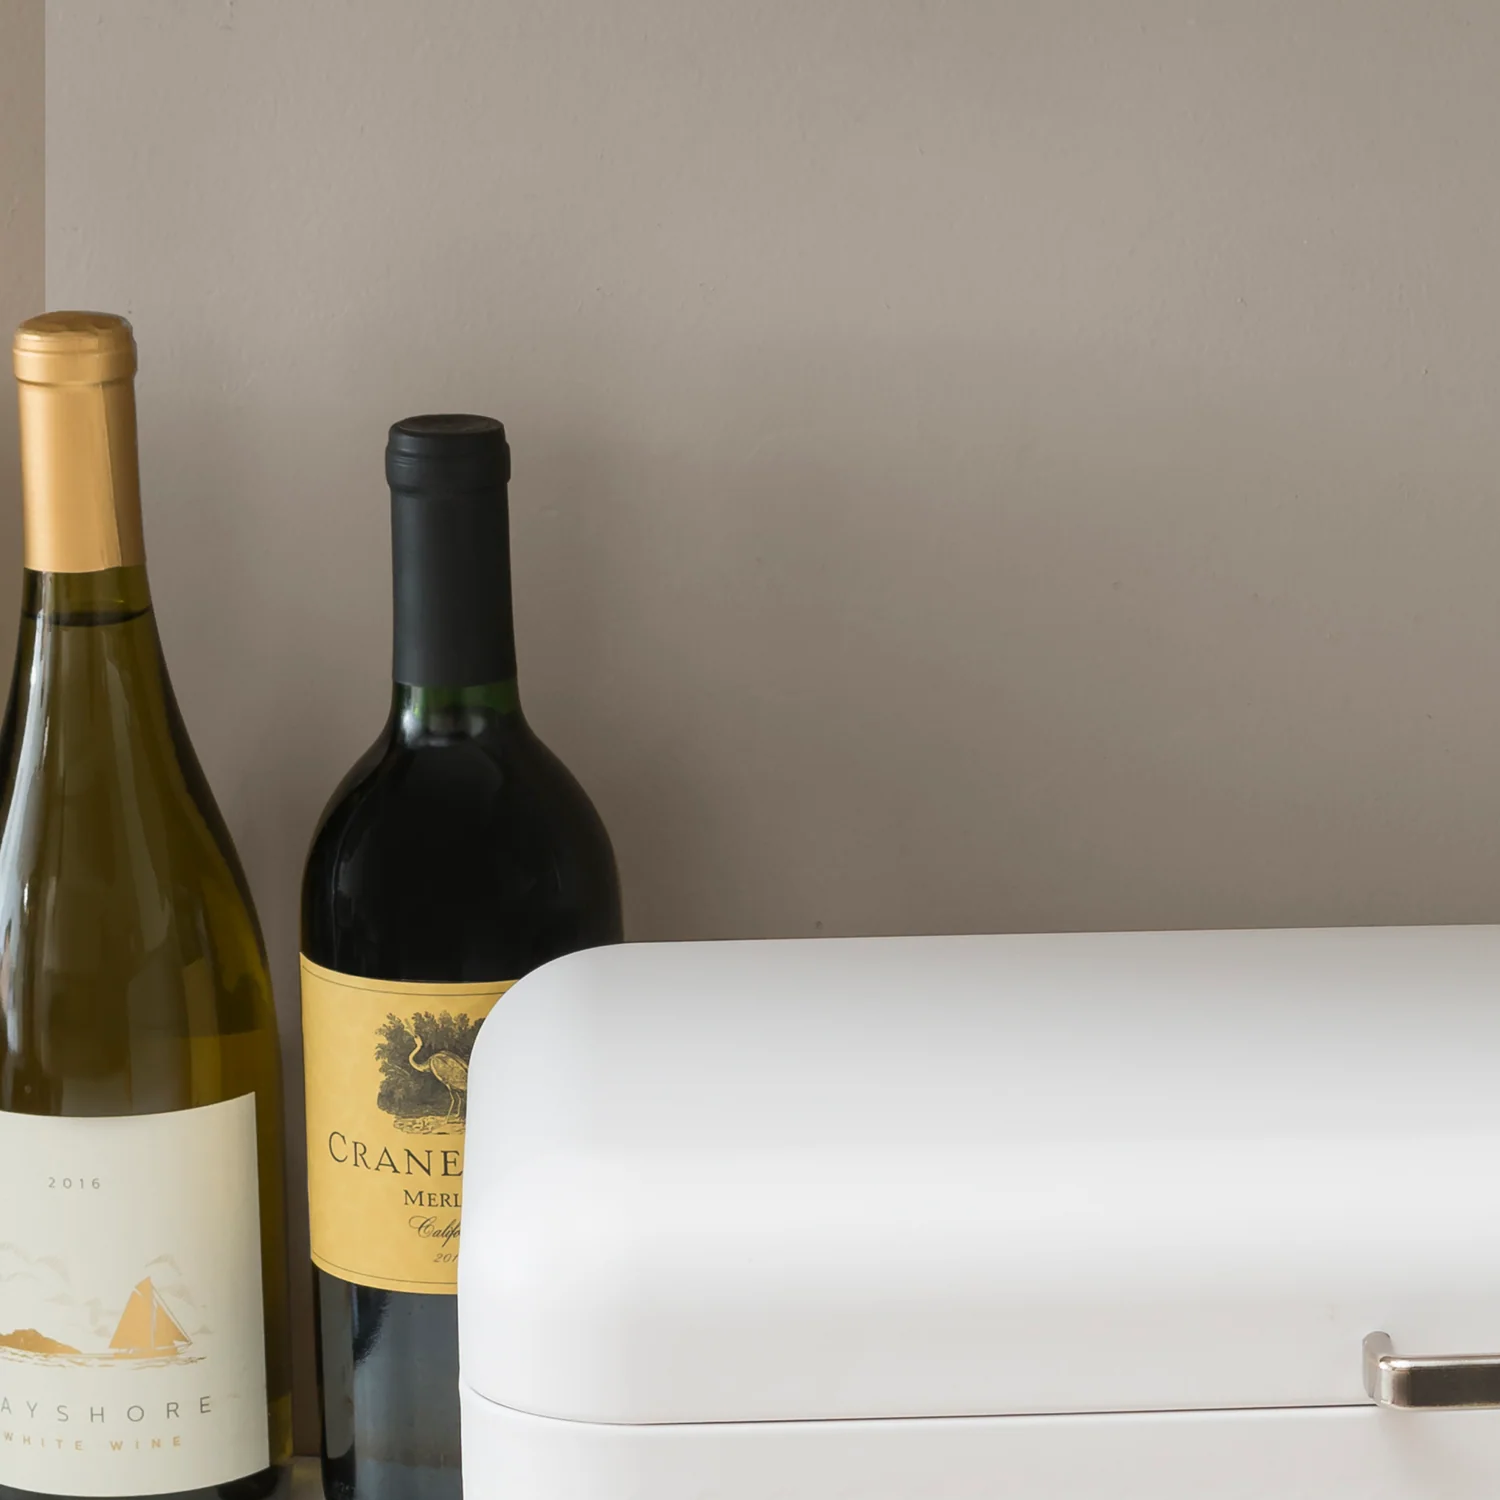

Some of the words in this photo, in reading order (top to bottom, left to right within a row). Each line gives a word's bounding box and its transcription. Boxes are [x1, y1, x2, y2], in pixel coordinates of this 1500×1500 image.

[328, 1131, 463, 1177] CRANE
[47, 1176, 101, 1190] 2016
[403, 1189, 462, 1208] MERL
[0, 1395, 212, 1423] AYSHORE
[3, 1431, 84, 1451] WHITE
[109, 1435, 181, 1452] WINE
